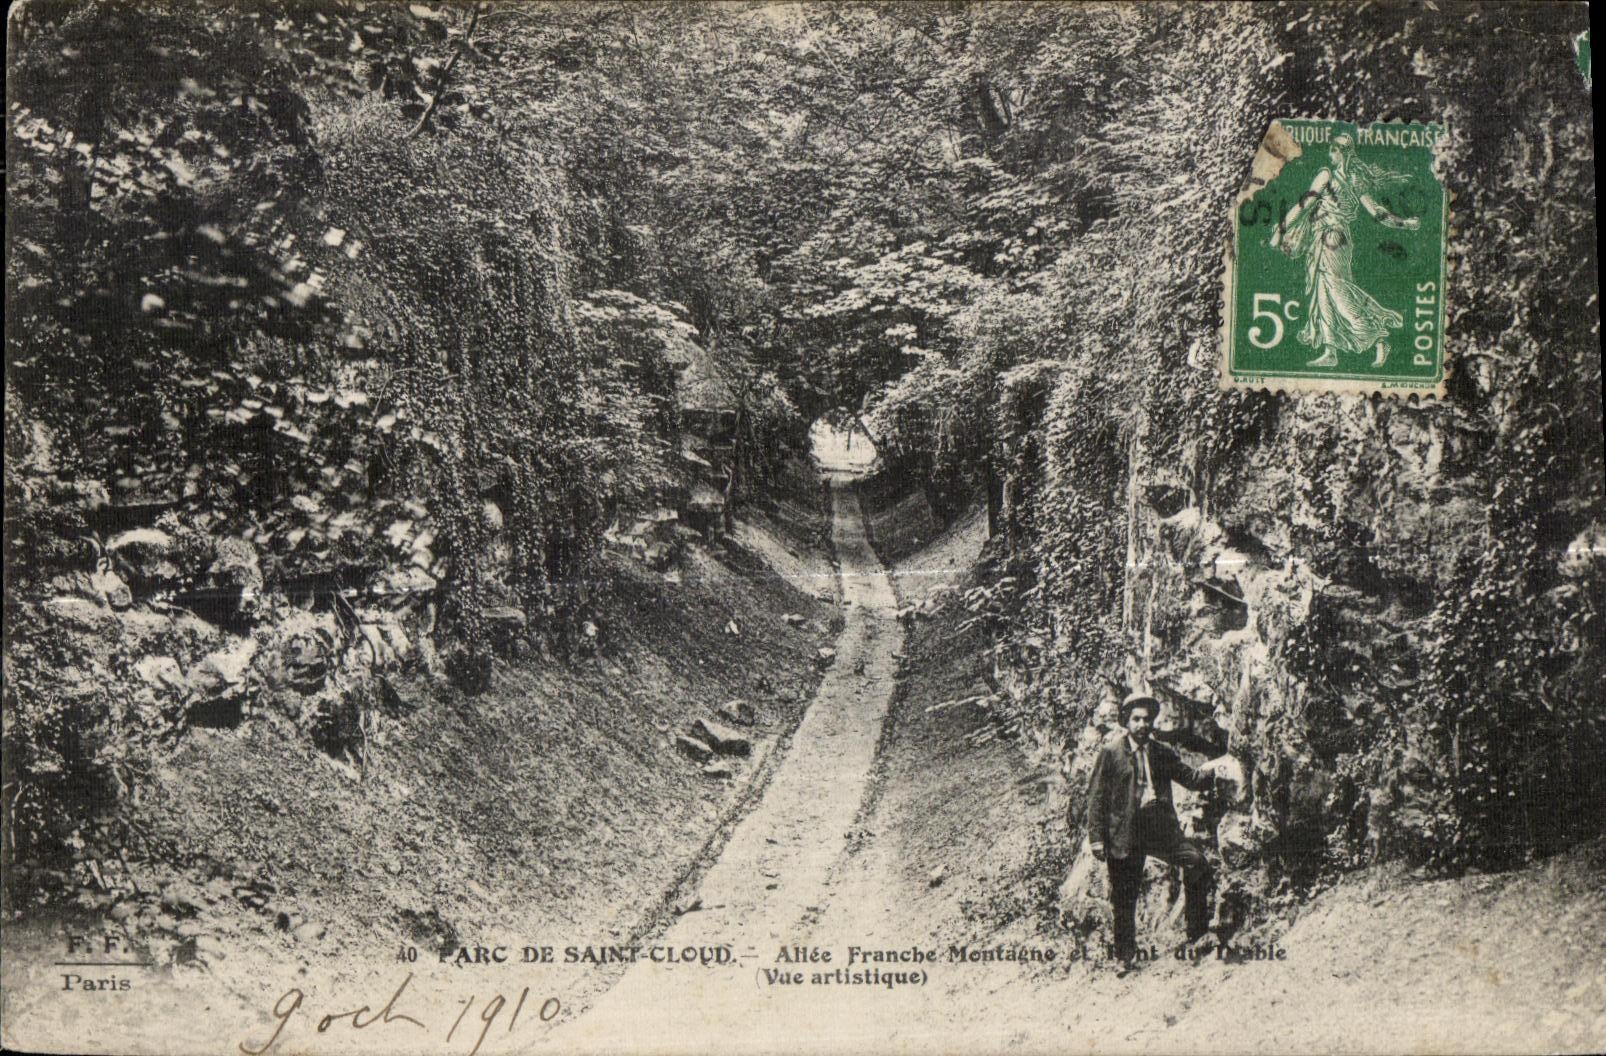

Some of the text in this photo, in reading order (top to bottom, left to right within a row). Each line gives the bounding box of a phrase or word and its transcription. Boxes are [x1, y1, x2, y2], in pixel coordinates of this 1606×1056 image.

[1283, 125, 1331, 147] BLIQUE
[1413, 281, 1436, 366] POSTES
[446, 986, 561, 1056] 1910
